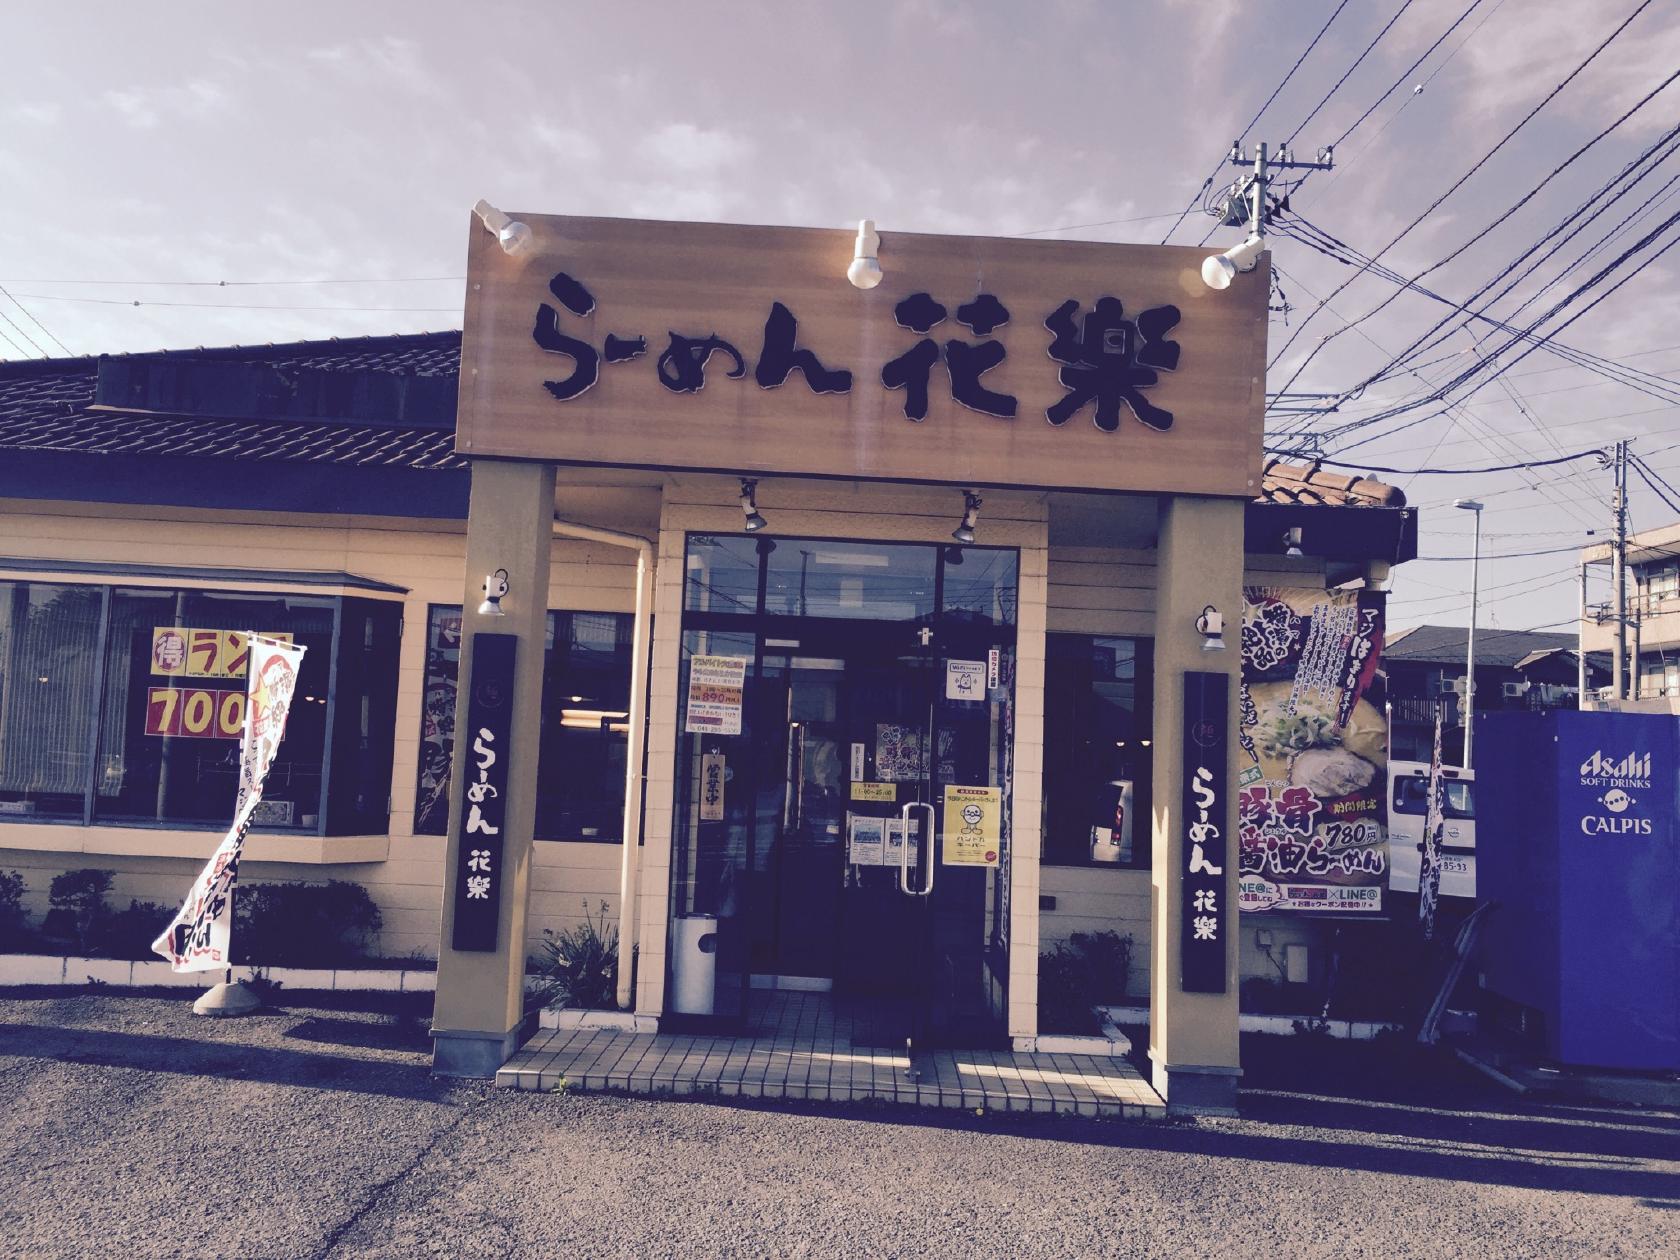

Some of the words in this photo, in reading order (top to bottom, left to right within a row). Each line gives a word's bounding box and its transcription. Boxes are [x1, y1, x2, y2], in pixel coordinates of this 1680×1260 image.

[532, 272, 853, 401] らーめん
[466, 727, 499, 835] らーめん
[705, 763, 721, 806] 営業中
[1580, 750, 1651, 779] Asahi
[1580, 777, 1608, 786] SOFT
[1610, 778, 1651, 788] DRINKS
[1188, 766, 1223, 875] らーめん
[1581, 815, 1652, 835] CALPIS
